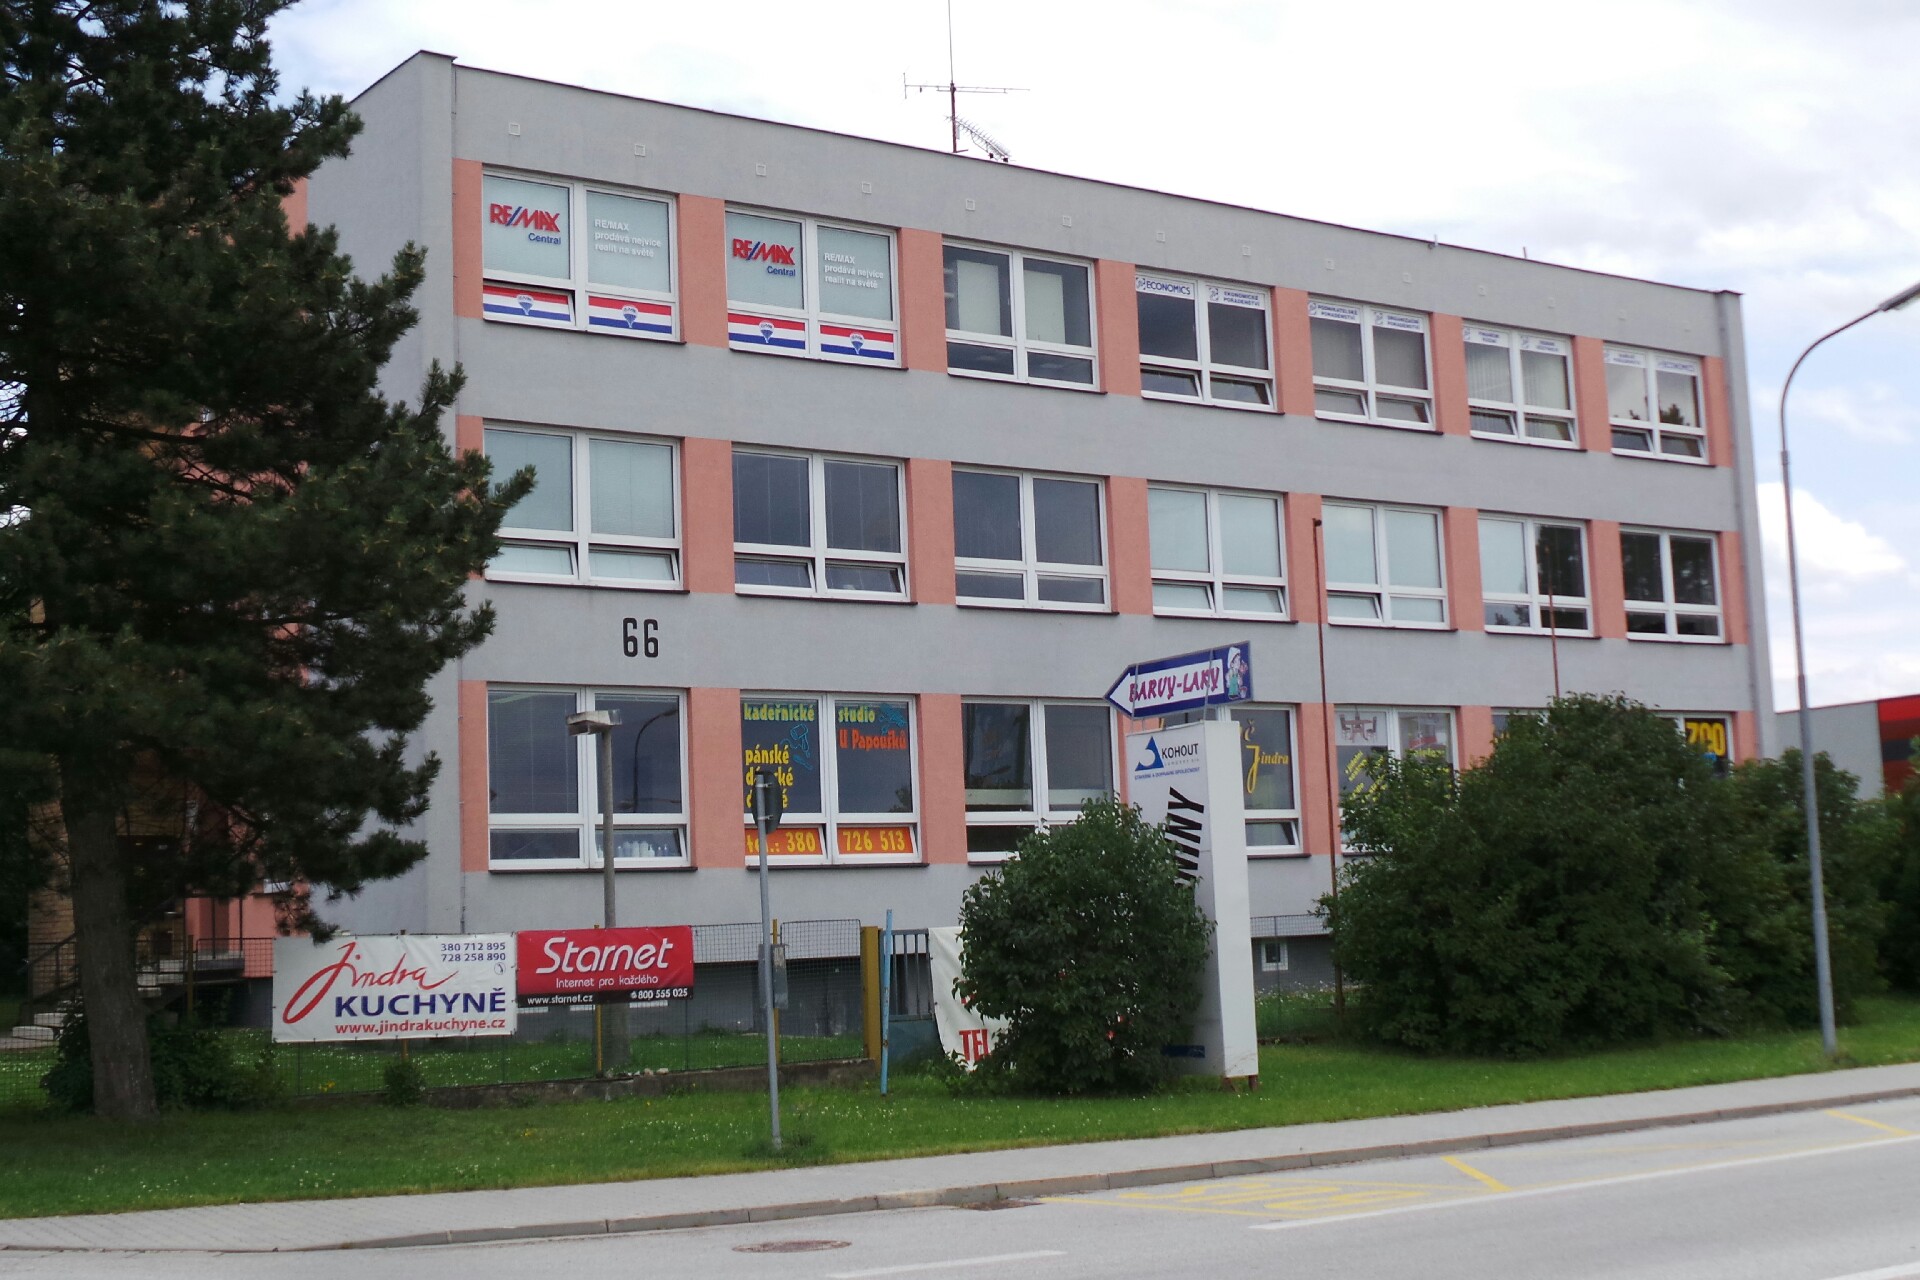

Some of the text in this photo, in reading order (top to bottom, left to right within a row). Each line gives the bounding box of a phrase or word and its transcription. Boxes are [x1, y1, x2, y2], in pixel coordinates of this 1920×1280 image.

[489, 203, 561, 232] RE/MAX
[594, 219, 629, 231] RE/MAX
[528, 232, 561, 246] Central
[619, 246, 630, 254] na
[732, 238, 796, 266] RE/MAX
[824, 252, 856, 264] RE/MAX
[766, 264, 797, 278] Central
[846, 278, 856, 286] na
[1146, 280, 1191, 296] ECONOMICS
[622, 617, 659, 658] 66
[1129, 667, 1220, 702] BARVY-LAKY
[743, 702, 876, 723] kadeřnické studio
[839, 729, 848, 748] U
[745, 743, 790, 765] pánské
[1162, 743, 1199, 760] KOHOUT
[1246, 745, 1289, 794] Jindra
[786, 832, 816, 853] 380
[843, 831, 873, 852] 726
[880, 831, 905, 852] 513
[441, 942, 506, 951] 380 712 895
[441, 952, 506, 962] 728 258 890
[536, 936, 674, 975] Starnet
[282, 941, 459, 1024] Jindra
[556, 974, 659, 990] Internet pro každého
[527, 994, 593, 1005] www.starnet.cz
[638, 988, 688, 1000] 800 555 025
[335, 987, 506, 1018] KUCHYNĚ
[335, 1018, 506, 1034] www.jindrakuchyne.cz
